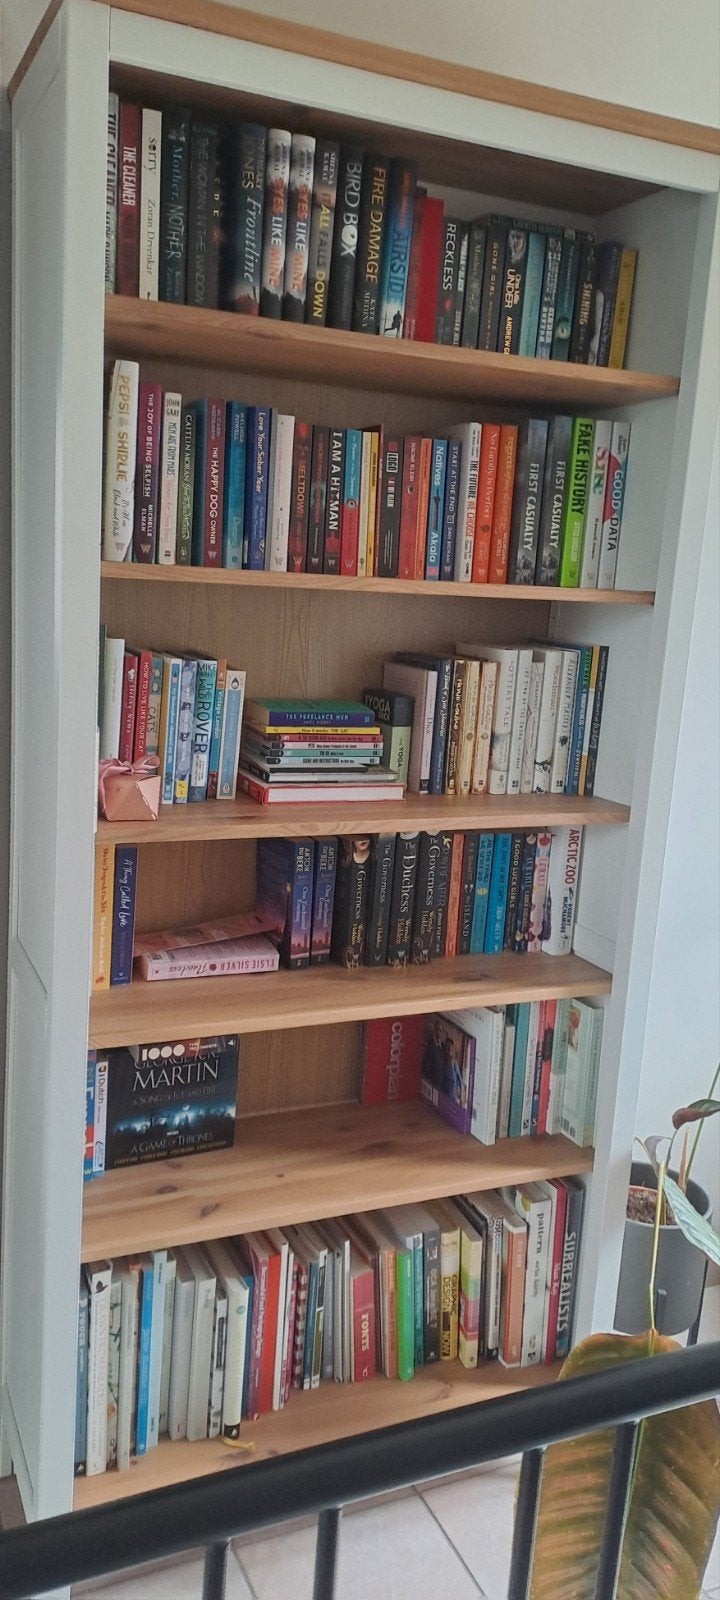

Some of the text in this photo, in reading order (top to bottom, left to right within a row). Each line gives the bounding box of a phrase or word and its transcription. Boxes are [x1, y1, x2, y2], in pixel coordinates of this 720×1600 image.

[143, 135, 157, 173] sorry
[121, 146, 137, 204] THE CLEANER
[344, 161, 363, 208] BIRD
[270, 216, 284, 246] LIKE
[318, 204, 330, 229] ALL
[365, 166, 386, 284] FIRE DAMAGE
[243, 196, 262, 283] Frontline
[294, 221, 308, 249] LIKE
[268, 247, 282, 286] MINE
[292, 252, 305, 291] MINE
[442, 223, 457, 291] RECKLESS
[488, 242, 500, 298] GONE GIRL
[311, 271, 327, 317] DOWN
[503, 268, 516, 309] UNDER
[578, 282, 593, 326] SHINING
[502, 315, 513, 346] ANDREW
[115, 374, 131, 482] PEPSI SHIRLIE
[168, 422, 177, 433] MEN
[257, 411, 266, 431] Love
[143, 393, 155, 498] THE JOY BEING SELFISH
[166, 446, 176, 460] FROM
[182, 413, 194, 482] CAITLIN MORAN
[211, 447, 219, 459] THE
[256, 432, 266, 449] Your
[330, 440, 342, 461] AM
[576, 423, 593, 455] FAKE
[210, 460, 220, 491] HAPPY
[255, 451, 265, 474] Sober
[330, 464, 340, 474] A
[433, 446, 445, 486] Natives
[470, 460, 480, 472] THE
[485, 446, 496, 474] Family
[254, 475, 264, 493] Year
[296, 461, 307, 517] MELTDOWN
[448, 446, 460, 511] START AT THE END
[467, 473, 479, 499] FUTURE
[570, 460, 590, 515] HISTORY
[611, 469, 625, 507] GOOD
[140, 507, 148, 531] ELMAN
[209, 494, 219, 518] DOG
[483, 486, 493, 518] Perfect
[522, 462, 541, 550] FIRST CASUALTY
[549, 460, 567, 549] FIRST CASUALTY
[145, 503, 154, 537] MICHELLE
[209, 520, 217, 544] OWNER
[607, 515, 620, 550] DATA
[429, 530, 439, 563] Akala
[141, 661, 150, 677] HOW
[142, 679, 149, 689] TO
[141, 690, 149, 703] LIVE
[139, 721, 147, 737] YOUR
[146, 705, 157, 732] CATS
[194, 701, 212, 754] ROVER
[213, 690, 225, 739] Vintage London
[286, 713, 297, 721] THE
[300, 713, 333, 721] FREELANCE
[295, 855, 304, 873] BEKE
[302, 847, 311, 873] ANTON
[319, 854, 327, 871] BEKE
[327, 847, 336, 871] ANTON
[563, 829, 581, 885] ARCTIC ZOO
[379, 857, 392, 903] Governess
[399, 852, 417, 913] Duchess
[425, 844, 441, 906] Governess
[509, 843, 521, 908] GOOD LUCK GIRLS
[118, 866, 132, 928] Thing Called Love
[354, 870, 368, 920] Governess
[462, 904, 471, 938] ISLAND
[560, 896, 570, 934] MUCHAMORE
[566, 903, 575, 927] ROBERT
[168, 959, 276, 976] ELSIE SILVER Flawless
[141, 1044, 186, 1062] 1000
[98, 1077, 107, 1103] Dutch
[132, 1060, 220, 1091] MARTIN
[535, 1212, 546, 1254] pattern
[552, 1262, 561, 1278] Man
[556, 1231, 577, 1332] SURREALISTS
[450, 1275, 459, 1315] GRAPHIC
[360, 1312, 371, 1352] FONTS
[442, 1276, 452, 1354] DESIGN NOW
